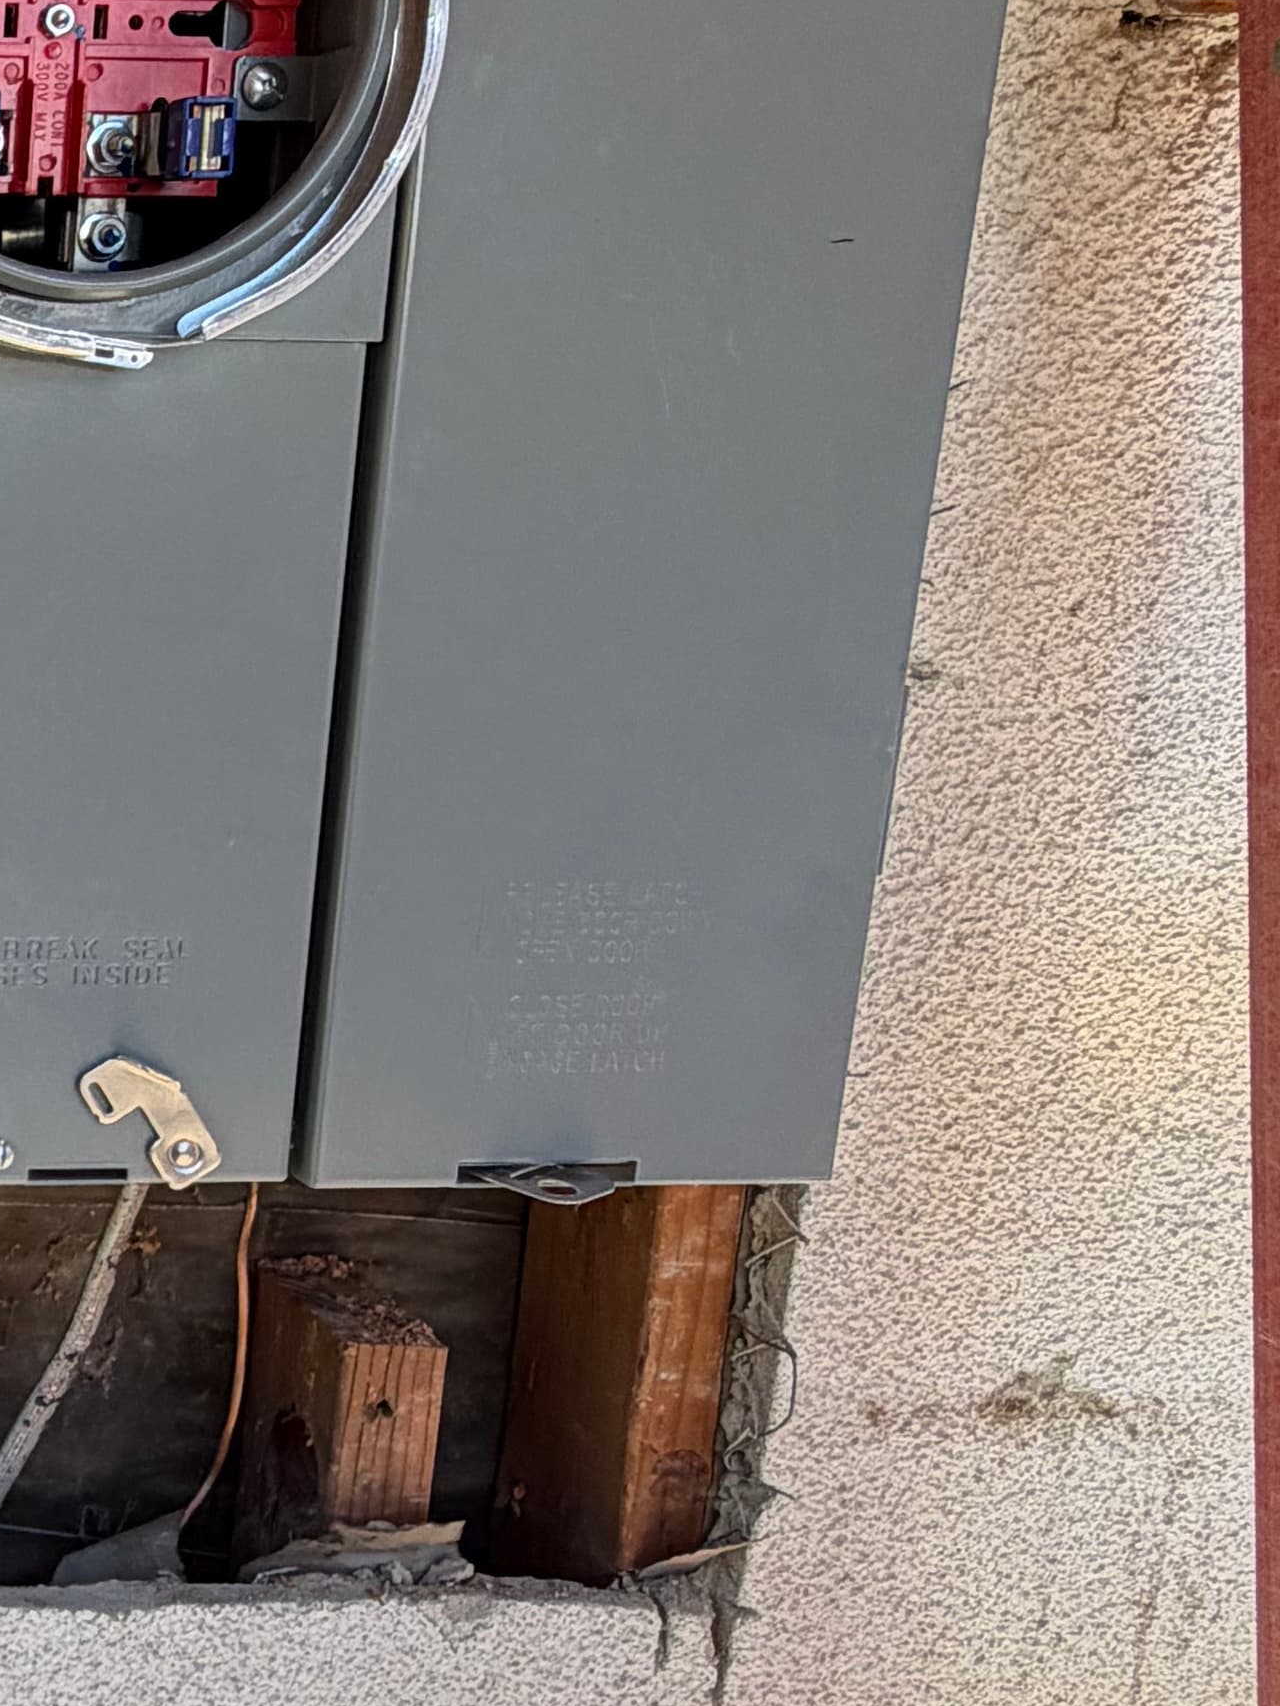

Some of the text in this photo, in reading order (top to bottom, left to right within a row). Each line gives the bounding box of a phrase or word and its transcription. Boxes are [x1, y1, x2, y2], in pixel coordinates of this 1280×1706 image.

[35, 61, 51, 102] 300V
[53, 62, 70, 101] 200A
[2, 936, 100, 961] BREAK
[123, 936, 190, 961] SEAL
[72, 962, 172, 987] INSIDE
